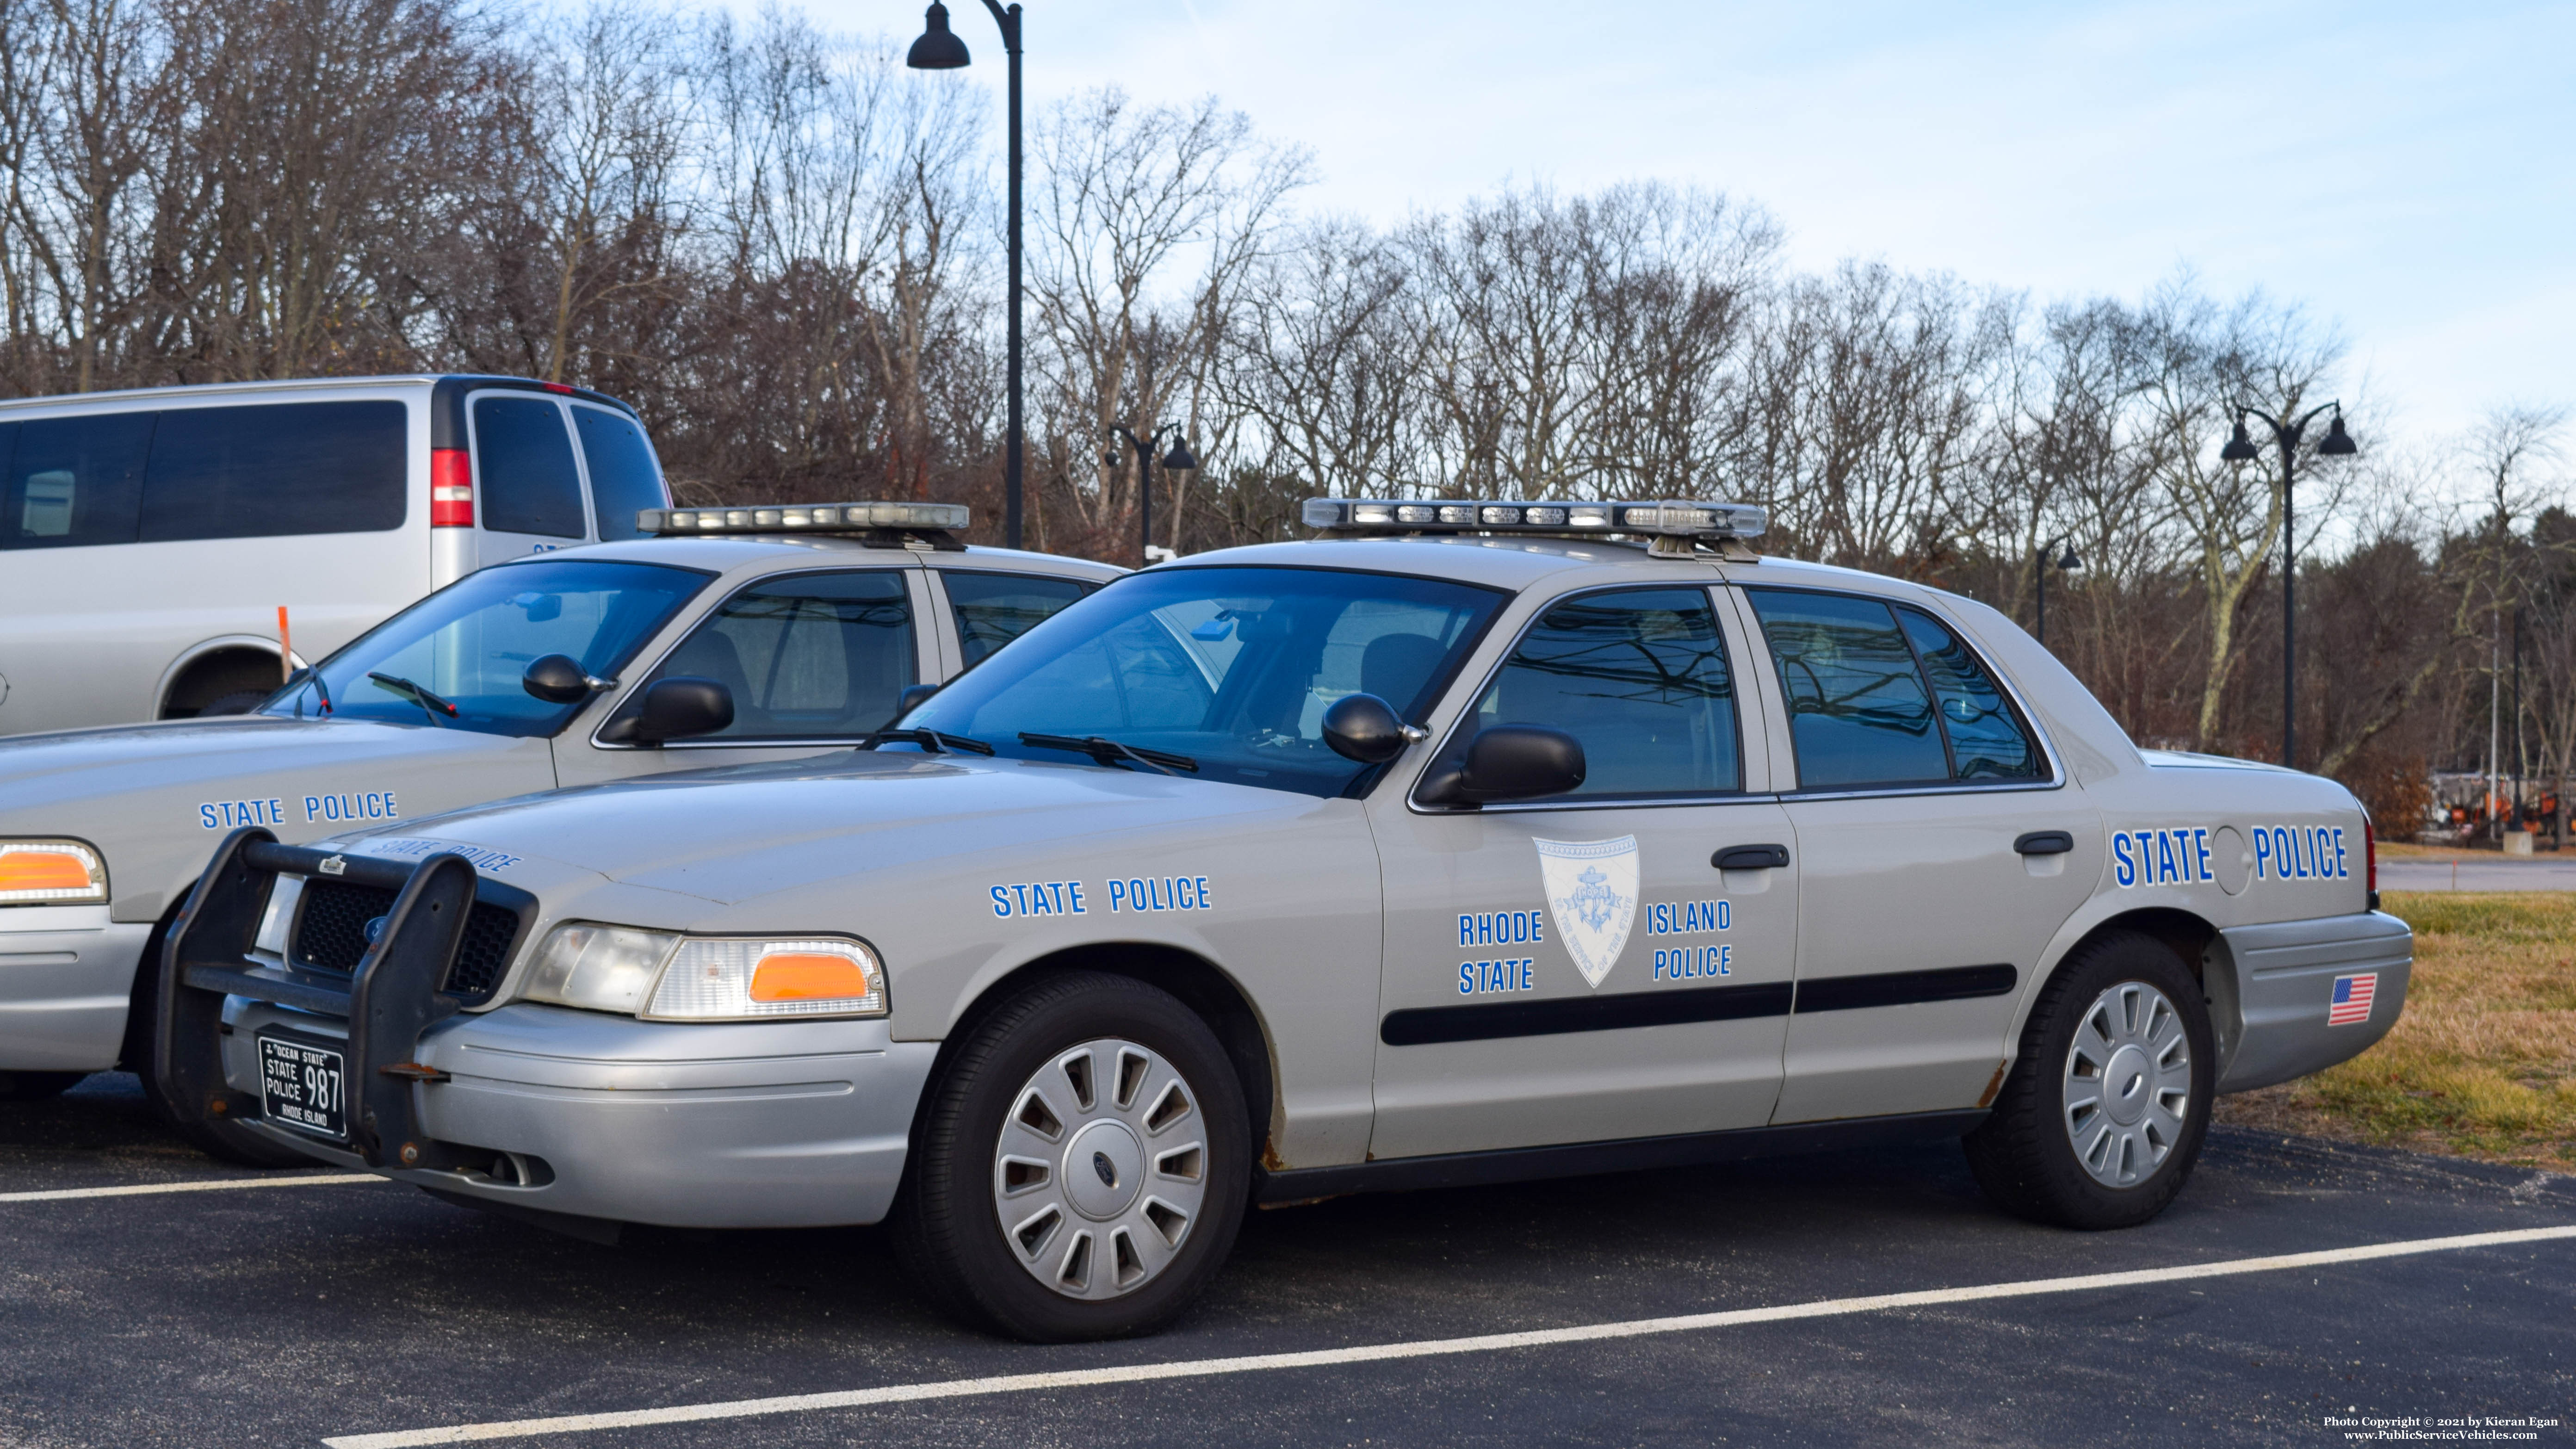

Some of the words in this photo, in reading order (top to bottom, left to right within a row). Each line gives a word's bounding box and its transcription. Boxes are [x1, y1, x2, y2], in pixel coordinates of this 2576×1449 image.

[200, 798, 285, 830] STATE
[304, 791, 398, 823] POLICE
[371, 840, 442, 855] STATE
[2112, 826, 2214, 889] STATE
[2251, 825, 2348, 881] POLICE
[989, 880, 1087, 919] STATE
[1106, 875, 1212, 913] POLICE
[1582, 888, 1604, 896] HOPE
[1458, 910, 1543, 947] RHODE
[1646, 899, 1731, 935] ISLAND
[1459, 958, 1533, 995] STATE
[1653, 945, 1732, 982] POLICE
[1598, 955, 1608, 971] OF
[1607, 933, 1622, 954] THE
[267, 1059, 297, 1081] STATE
[305, 1065, 340, 1112] 987
[267, 1078, 301, 1101] POLICE
[283, 1104, 302, 1120] RHODE
[304, 1109, 327, 1127] ISLAND
